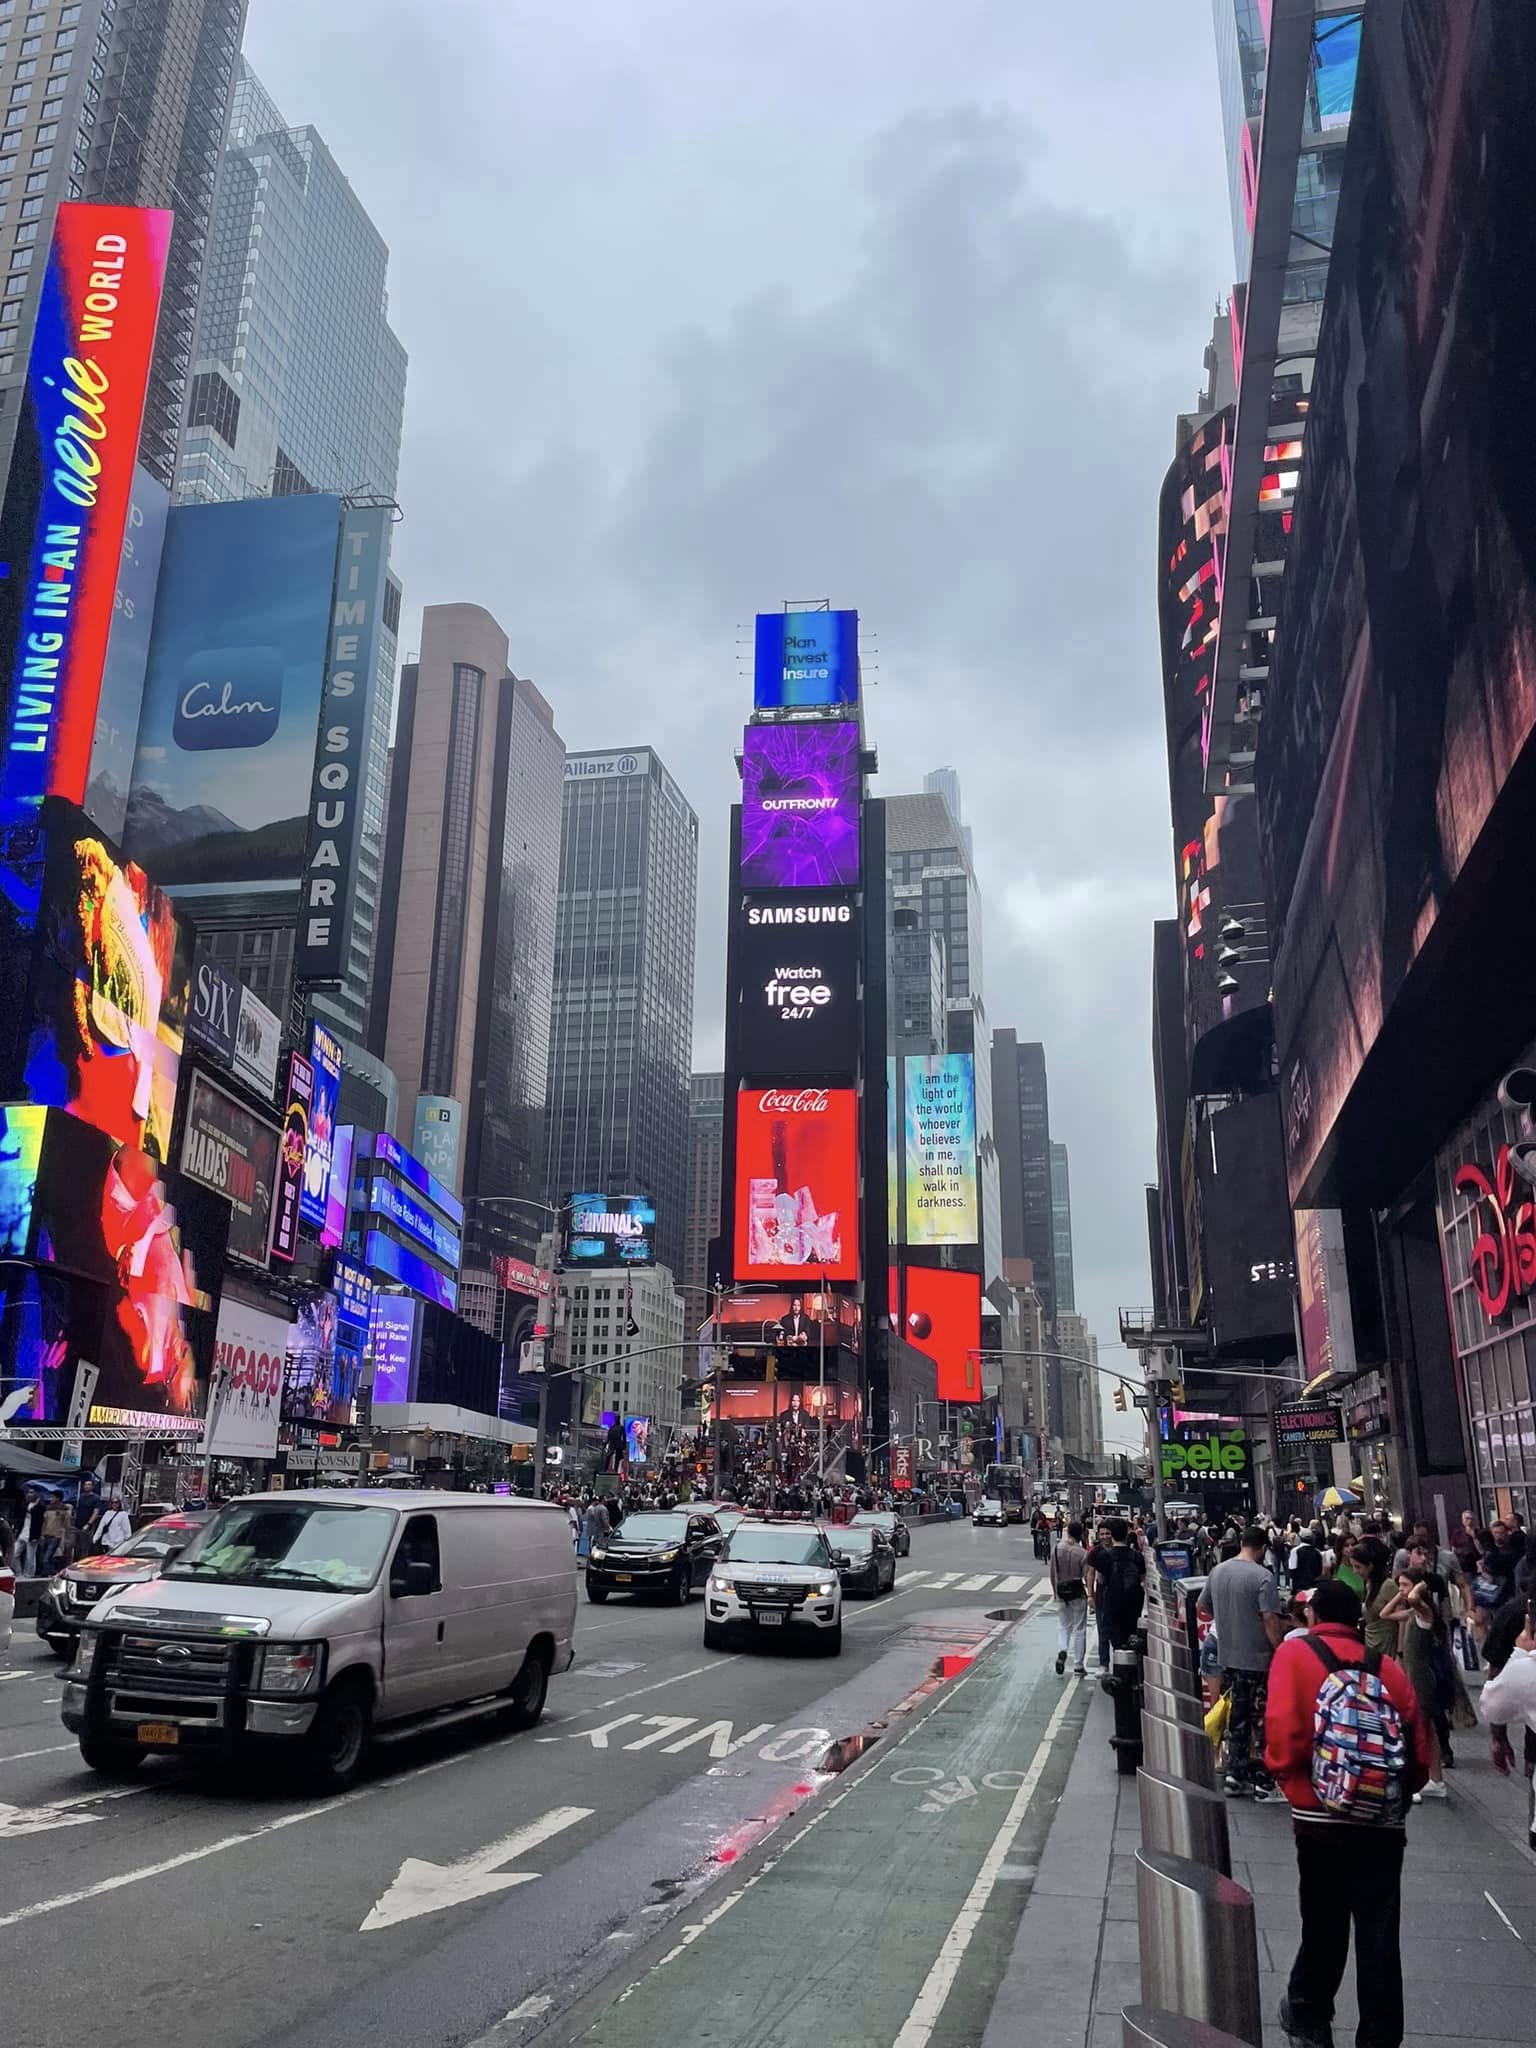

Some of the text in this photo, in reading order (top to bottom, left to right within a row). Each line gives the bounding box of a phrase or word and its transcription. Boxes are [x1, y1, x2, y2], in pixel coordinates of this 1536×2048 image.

[10, 232, 128, 753] LIVING IN AN aerie WORLD
[330, 530, 369, 698] TIMES
[784, 636, 816, 649] Plan
[783, 667, 829, 680] Insure
[180, 682, 274, 720] Calm
[564, 761, 615, 776] Allianz
[306, 725, 350, 947] SQUARE
[749, 906, 851, 925] SAMSUNG
[775, 967, 821, 979] Watch
[765, 980, 831, 1006] free
[194, 964, 235, 1040] SIX
[781, 1007, 814, 1020] 24/7
[315, 1024, 342, 1069] WINNR
[925, 1076, 941, 1084] am
[943, 1073, 960, 1083] the
[759, 1088, 830, 1112] Coca-Cola
[922, 1087, 958, 1102] light of
[916, 1102, 963, 1115] the world
[919, 1118, 962, 1130] whoever
[920, 1134, 961, 1146] believes
[925, 1149, 935, 1161] in
[919, 1164, 964, 1177] shall not
[923, 1179, 960, 1192] walk in
[917, 1196, 967, 1208] darkness.
[211, 1341, 281, 1397] HICAGO
[377, 1364, 397, 1374] High
[1280, 1412, 1338, 1430] ELECTRONICS
[1282, 1429, 1339, 1442] CAMERA LUGGAGE
[1181, 1470, 1235, 1479] SOCCER
[568, 1713, 832, 1762] ONLY
